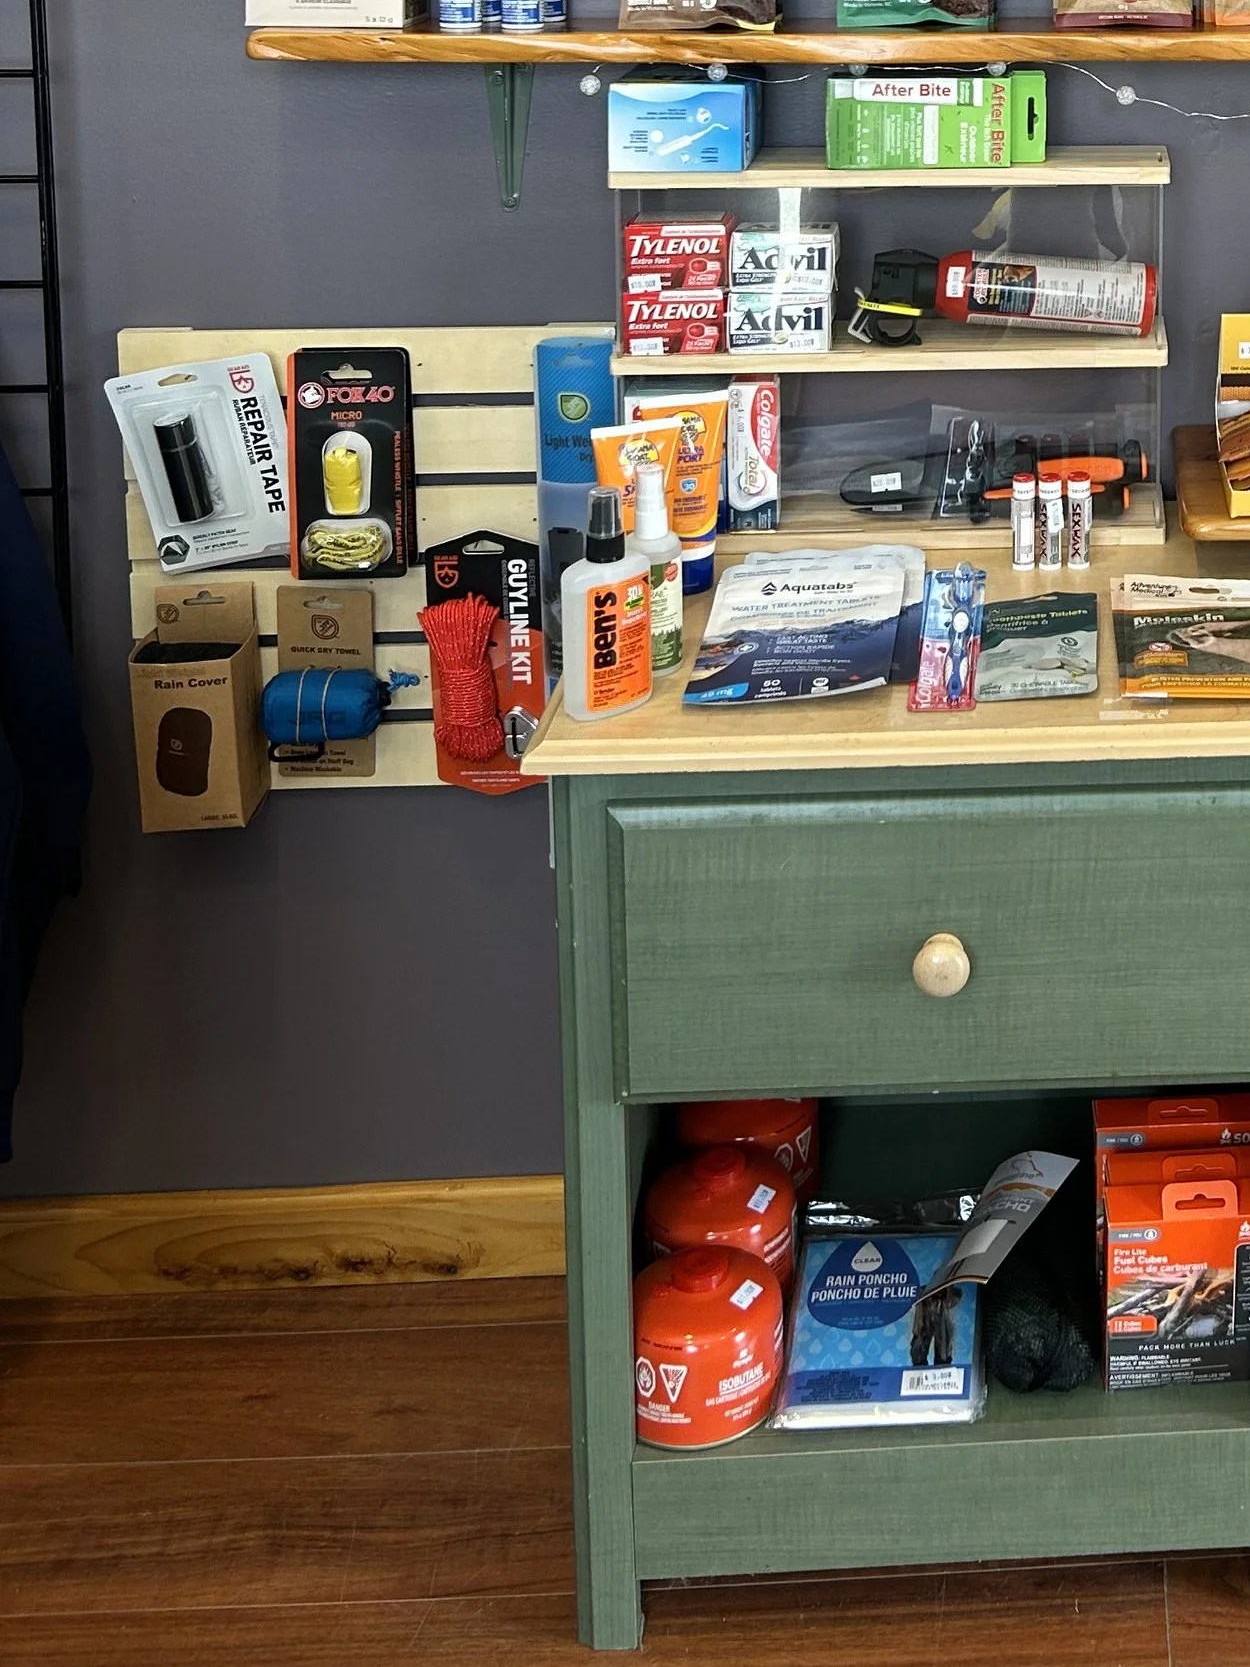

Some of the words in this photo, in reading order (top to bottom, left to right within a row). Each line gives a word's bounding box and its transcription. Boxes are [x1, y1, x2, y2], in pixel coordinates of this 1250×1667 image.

[872, 84, 914, 97] After
[919, 84, 951, 96] Bite
[992, 83, 1006, 126] After
[992, 131, 1005, 163] Bite
[629, 236, 721, 257] TYLENOL
[631, 257, 653, 265] Extra
[655, 257, 671, 265] fort
[627, 301, 719, 322] TYLENOL
[653, 322, 668, 330] fort
[232, 399, 244, 423] RUBAN
[331, 411, 363, 420] MICRO
[760, 389, 775, 456] Colgate
[241, 396, 273, 463] REPAIR
[260, 465, 286, 513] TAPE
[1072, 503, 1081, 559] SEXWAX
[528, 559, 536, 597] REFLECTIVE
[780, 582, 854, 594] Aquatabs
[507, 559, 531, 648] GUYLINE
[1133, 613, 1224, 627] Moleskin
[511, 651, 532, 685] KIT
[154, 680, 184, 690] Rain
[188, 676, 228, 688] Cover
[1113, 1265, 1146, 1274] Cubes
[1160, 1262, 1208, 1272] carburant
[1114, 1257, 1135, 1265] Fuel
[1137, 1256, 1168, 1265] Cubes
[826, 1275, 855, 1287] RAIN
[859, 1273, 908, 1285] PONCHO
[811, 1288, 861, 1303] PONCHO
[863, 1288, 880, 1299] DE
[883, 1286, 917, 1298] PLUIE
[1163, 1342, 1186, 1350] MORE
[719, 1362, 764, 1392] ISOBUTANE
